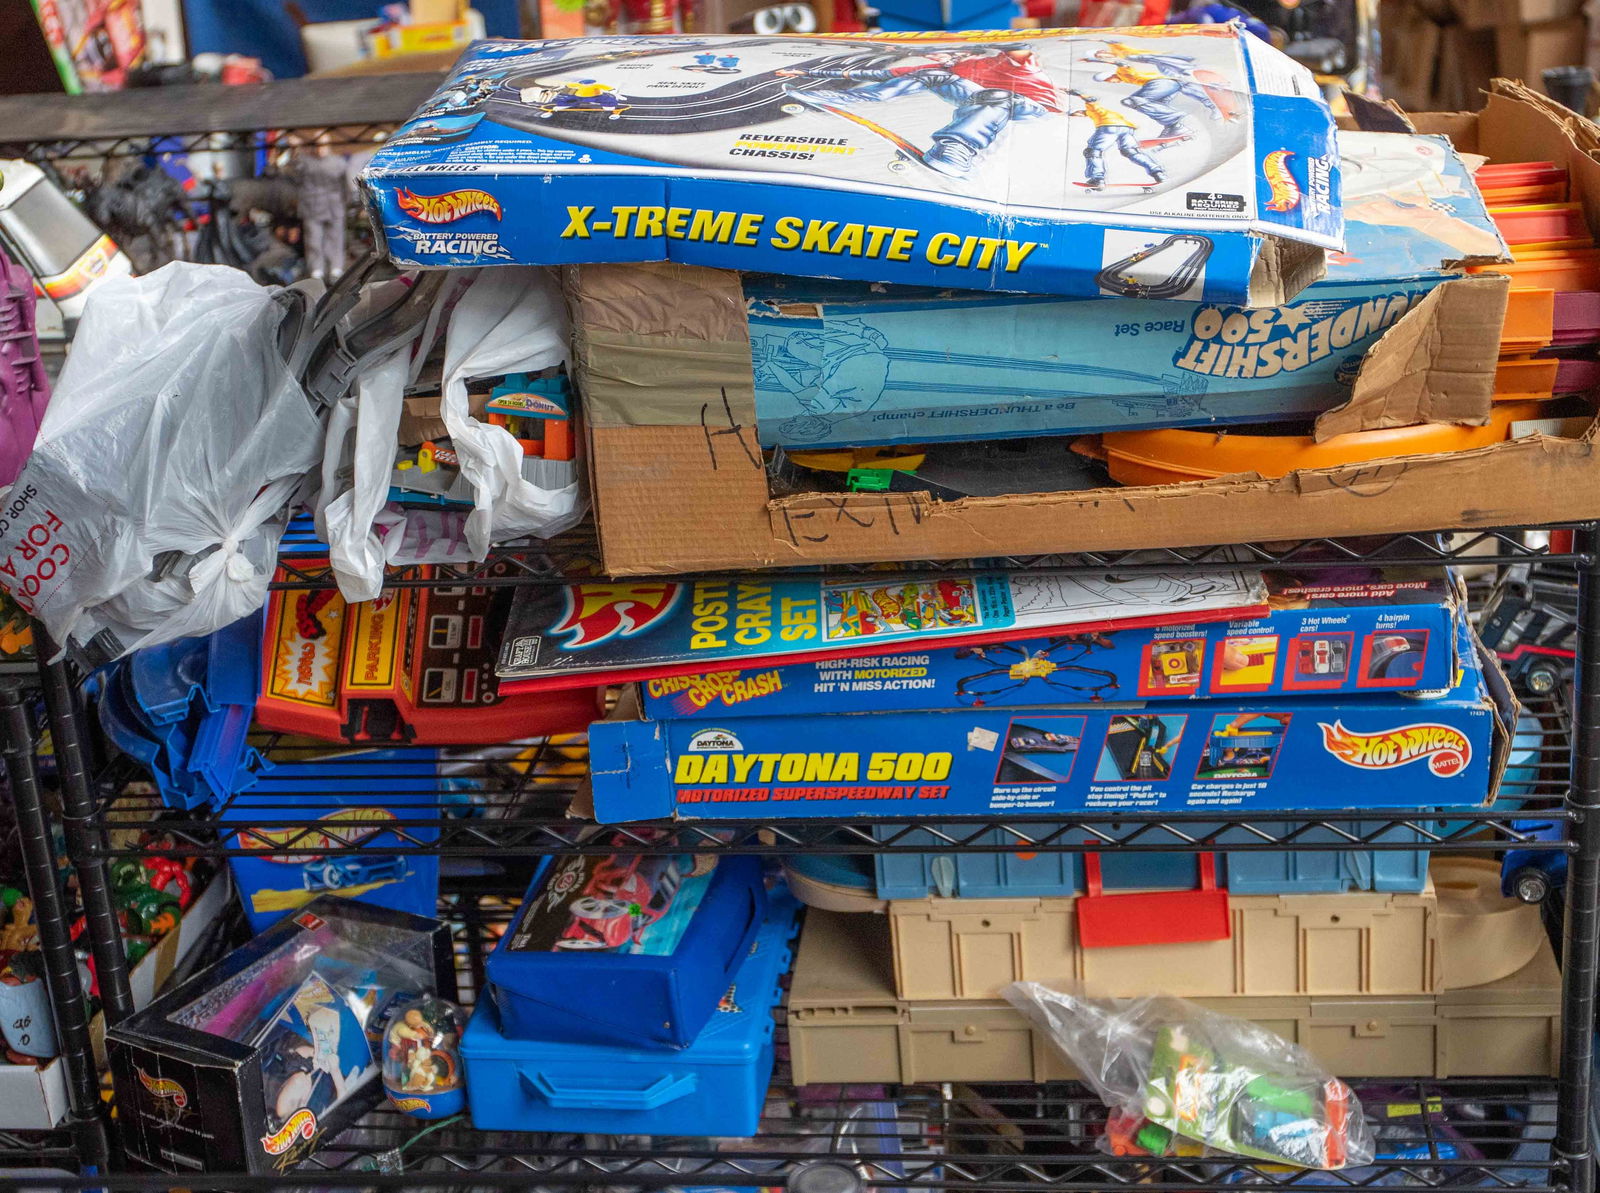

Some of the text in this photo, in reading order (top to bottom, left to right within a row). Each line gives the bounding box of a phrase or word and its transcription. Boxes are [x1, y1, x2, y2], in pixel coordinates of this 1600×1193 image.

[740, 134, 848, 146] REVERSIBLE
[729, 148, 815, 161] CHASSIS!
[1316, 158, 1331, 215] RACING
[1207, 192, 1216, 201] 4
[560, 206, 1038, 272] X-TREME SKATE CITY
[415, 240, 498, 254] RACING
[1115, 319, 1185, 336] Race Set
[1193, 304, 1278, 344] 500
[526, 398, 555, 411] DONUT
[1056, 402, 1075, 410] Be
[872, 411, 925, 422] champ!
[927, 405, 1041, 418] THUNDERSHIFT
[5, 484, 37, 519] SHOP.
[15, 509, 63, 560] FOR
[1283, 587, 1333, 595] crashes!
[1307, 592, 1335, 600] cars!
[734, 582, 772, 645] CRAY
[780, 597, 817, 641] SET
[1384, 613, 1410, 623] hairpin
[1229, 620, 1260, 628] Variable
[1307, 617, 1320, 625] Hot
[1375, 621, 1398, 629] turns!
[1161, 624, 1195, 632] motorized
[1226, 626, 1275, 636] speed control!
[1300, 624, 1319, 633] cars!
[1154, 630, 1207, 640] speed boosters!
[364, 613, 385, 681] PARKING
[815, 655, 930, 669] HIGH-RISK RACING
[820, 667, 927, 681] WITH MOTORIZED
[721, 670, 783, 706] CRASH
[814, 679, 936, 693] HIT 'N MISS ACTION!
[674, 752, 953, 784] DAYTONA 500
[1432, 757, 1461, 770] MATTEL
[1033, 785, 1057, 793] circuit
[1142, 784, 1153, 793] pit
[1205, 782, 1234, 791] charges
[1242, 782, 1256, 790] just
[676, 786, 951, 803] MOTORIZED SUPERSPEEDWAY SET
[991, 793, 1030, 801] side-by-side
[1087, 792, 1104, 800] stop
[1104, 792, 1128, 801] timing!
[1189, 789, 1256, 798] seconds! Recharge
[989, 800, 1055, 809] bumper-to-bumper!
[1085, 798, 1159, 808] recharge your racer!
[1187, 797, 1203, 806] again
[1221, 796, 1243, 805] again!
